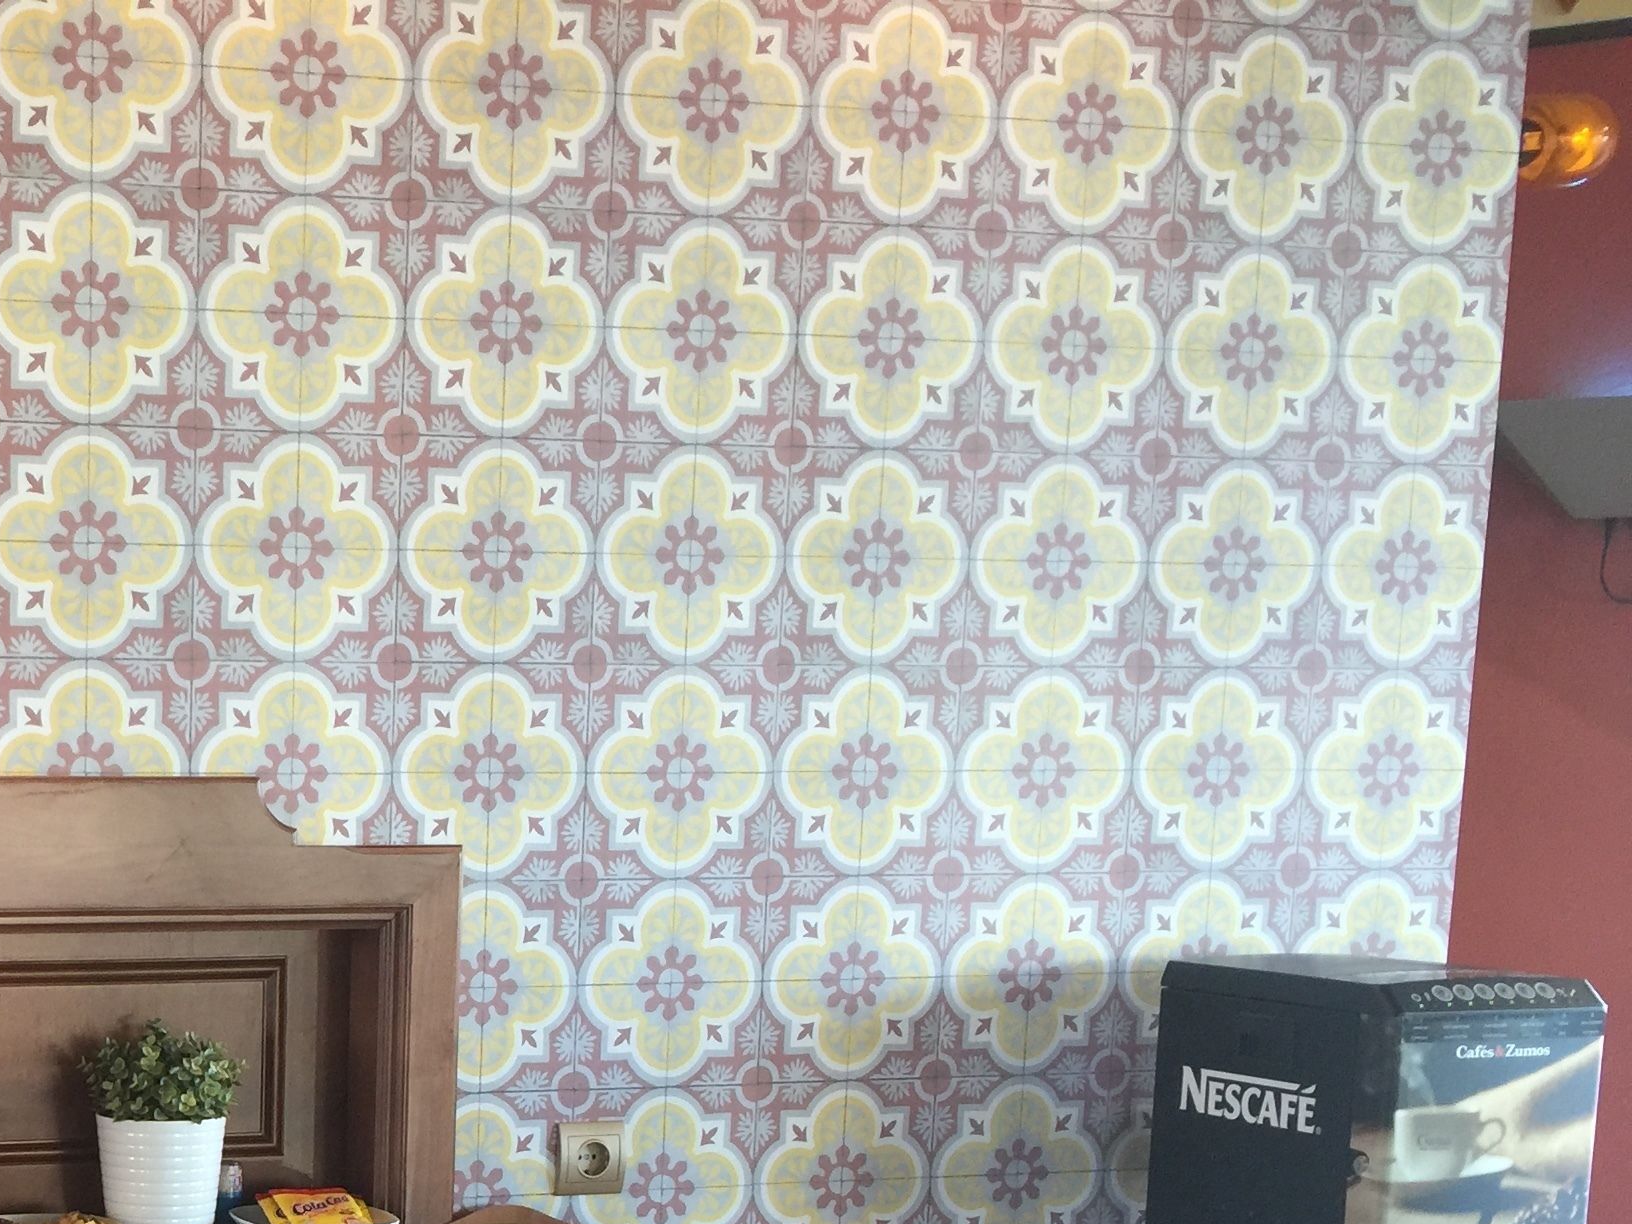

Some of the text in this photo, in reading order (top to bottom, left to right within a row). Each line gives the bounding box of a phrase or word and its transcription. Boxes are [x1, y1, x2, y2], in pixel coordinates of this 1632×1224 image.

[1456, 1044, 1495, 1059] Cafés
[1505, 1043, 1551, 1057] Zumos
[1179, 1065, 1317, 1134] NESCAFÉ
